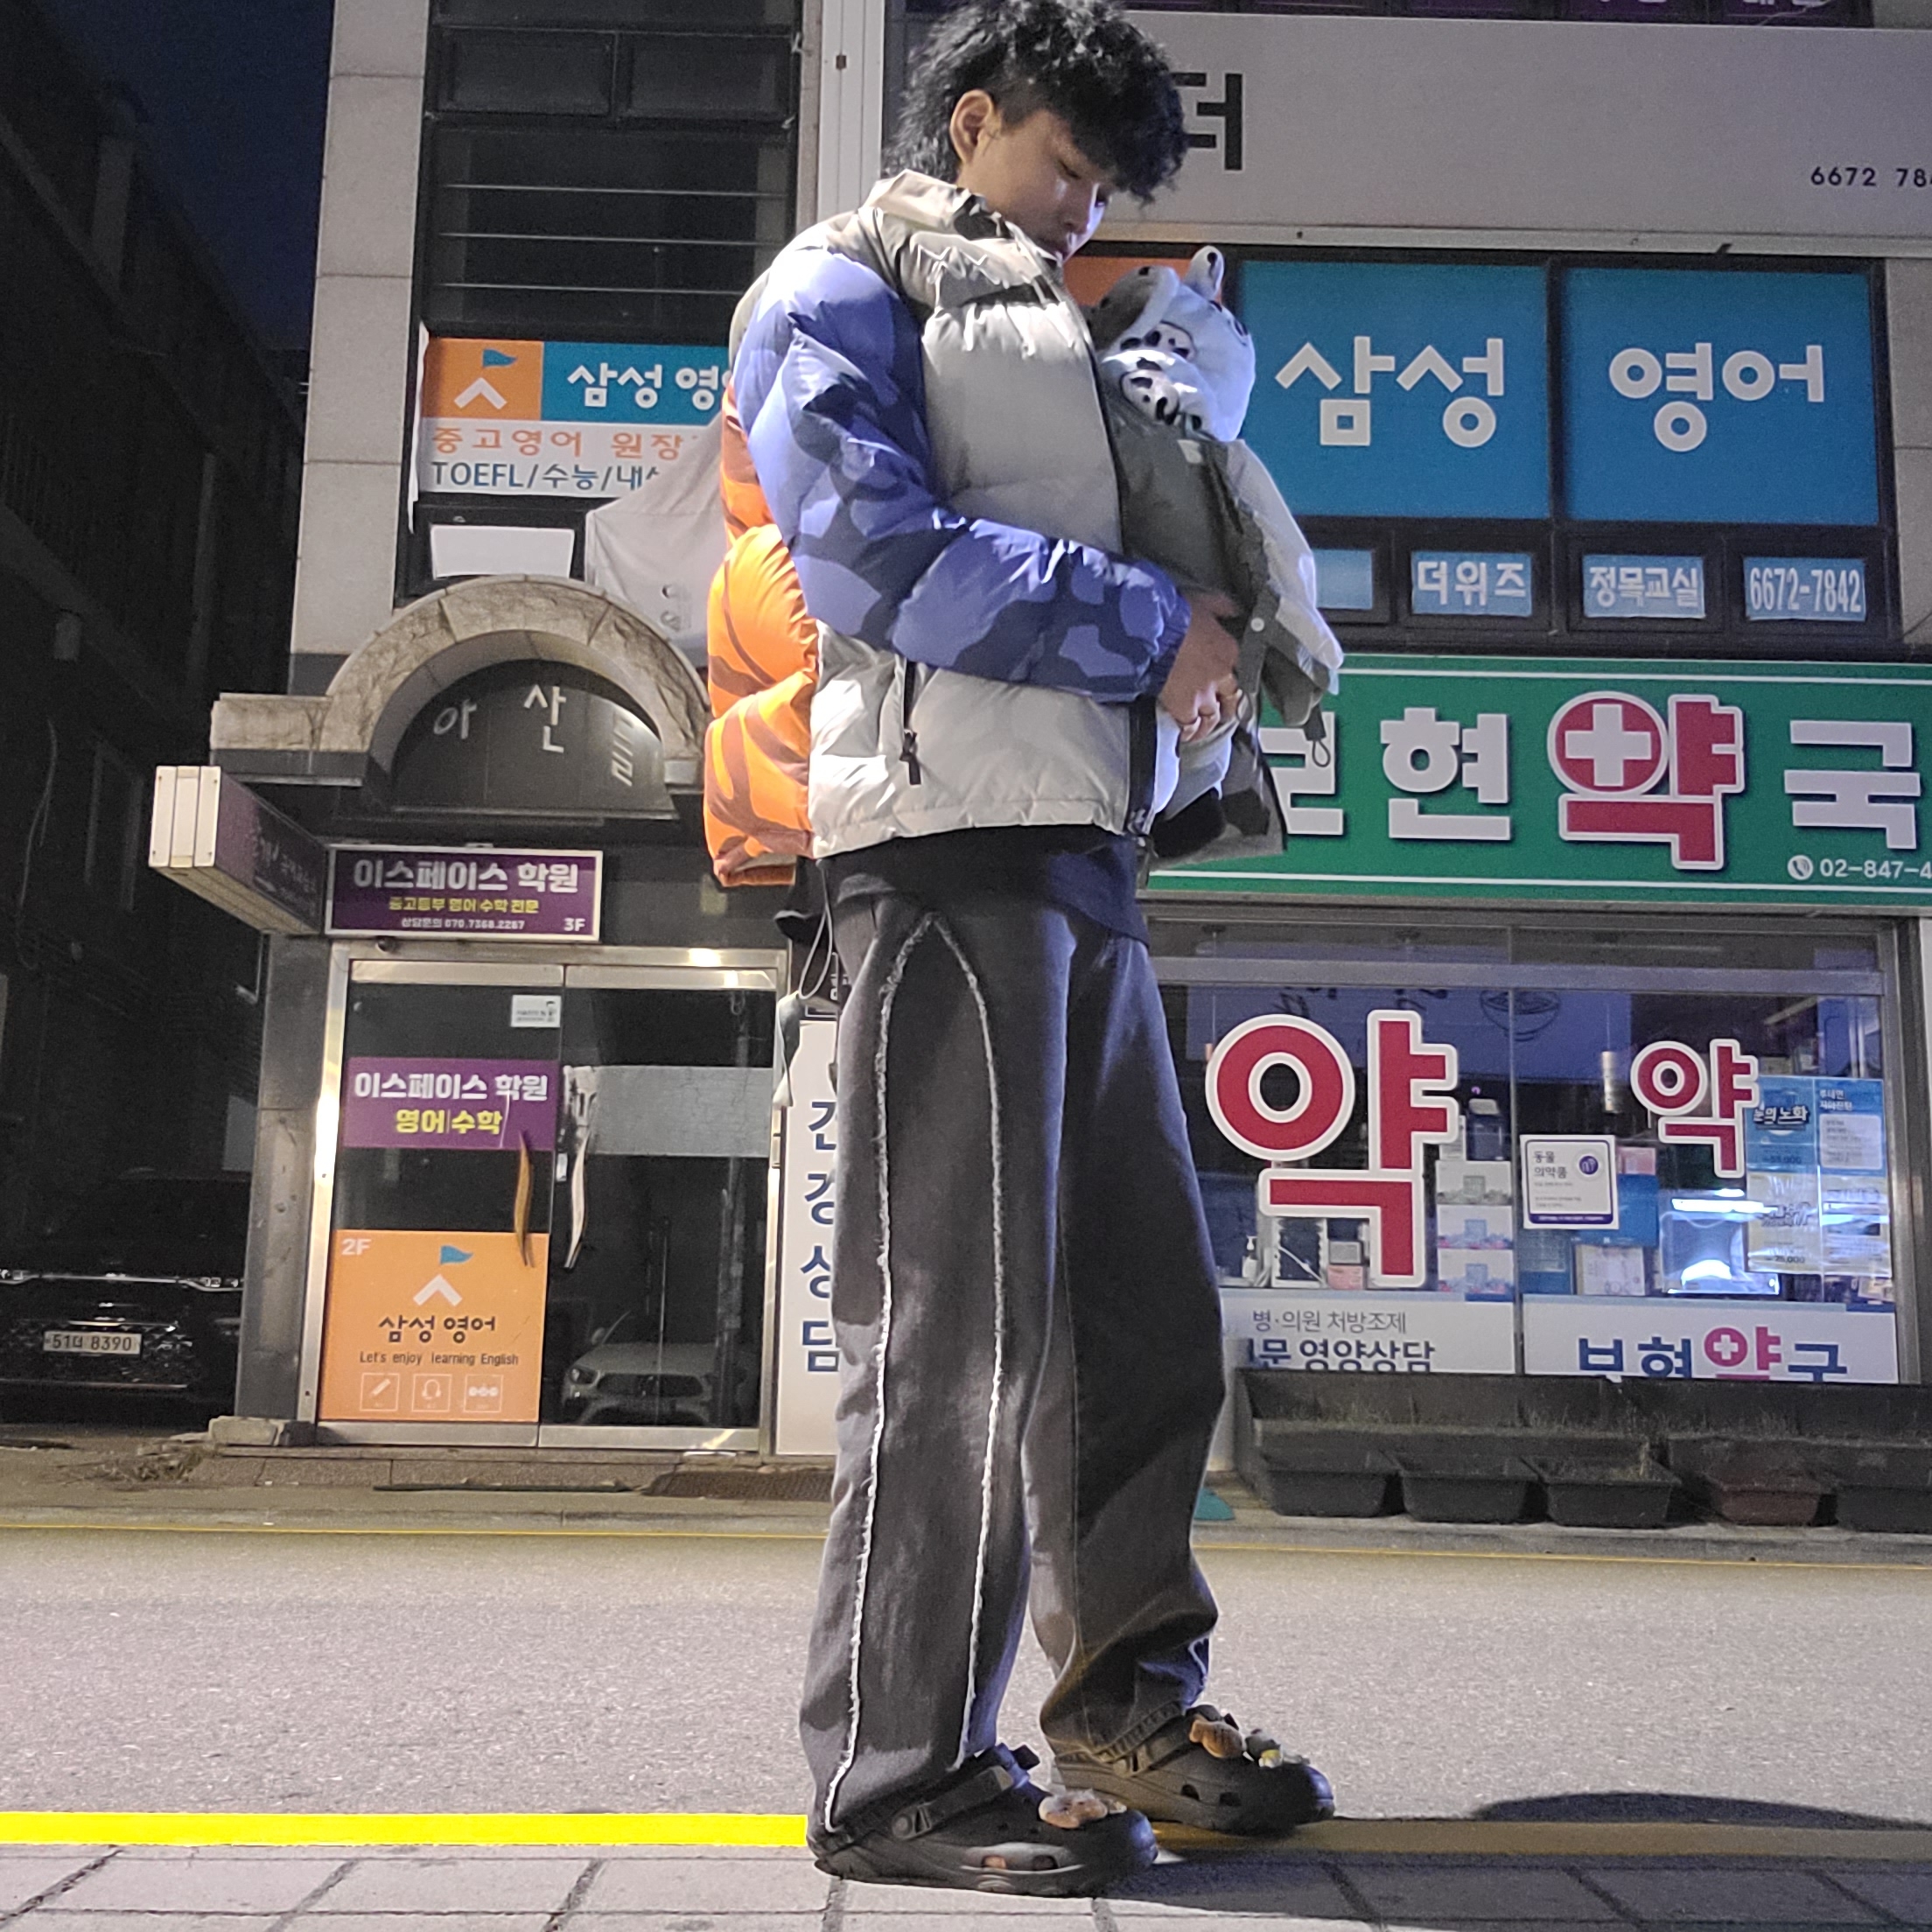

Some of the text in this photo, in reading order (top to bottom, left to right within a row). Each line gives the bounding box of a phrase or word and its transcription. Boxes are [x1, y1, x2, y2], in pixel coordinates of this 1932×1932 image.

[1810, 165, 1932, 188] 6672 78
[567, 361, 732, 410] 삼성 영
[1275, 336, 1824, 452] 삼성 영어
[432, 427, 699, 461] 중고영어 원장
[1589, 565, 1700, 607] 정목교실
[1750, 567, 1863, 614] 6672-7842
[354, 858, 579, 893] 이스페이스 학원
[564, 917, 585, 932] 3F
[354, 1072, 549, 1102] 이스페이스 학원
[396, 1109, 502, 1135] 영어 수학
[1631, 1039, 1760, 1178] 약
[1205, 1010, 1460, 1288] 약
[1534, 1152, 1554, 1164] 동물
[1534, 1166, 1567, 1180] 의약품
[341, 1238, 371, 1256] 2F
[379, 1315, 496, 1344] 삼성 영어
[1252, 1310, 1407, 1334] 병·의원 처방조제
[90, 1335, 132, 1352] 8390
[1248, 1337, 1292, 1368] 문
[360, 1351, 519, 1367] Let's enjoy learning English
